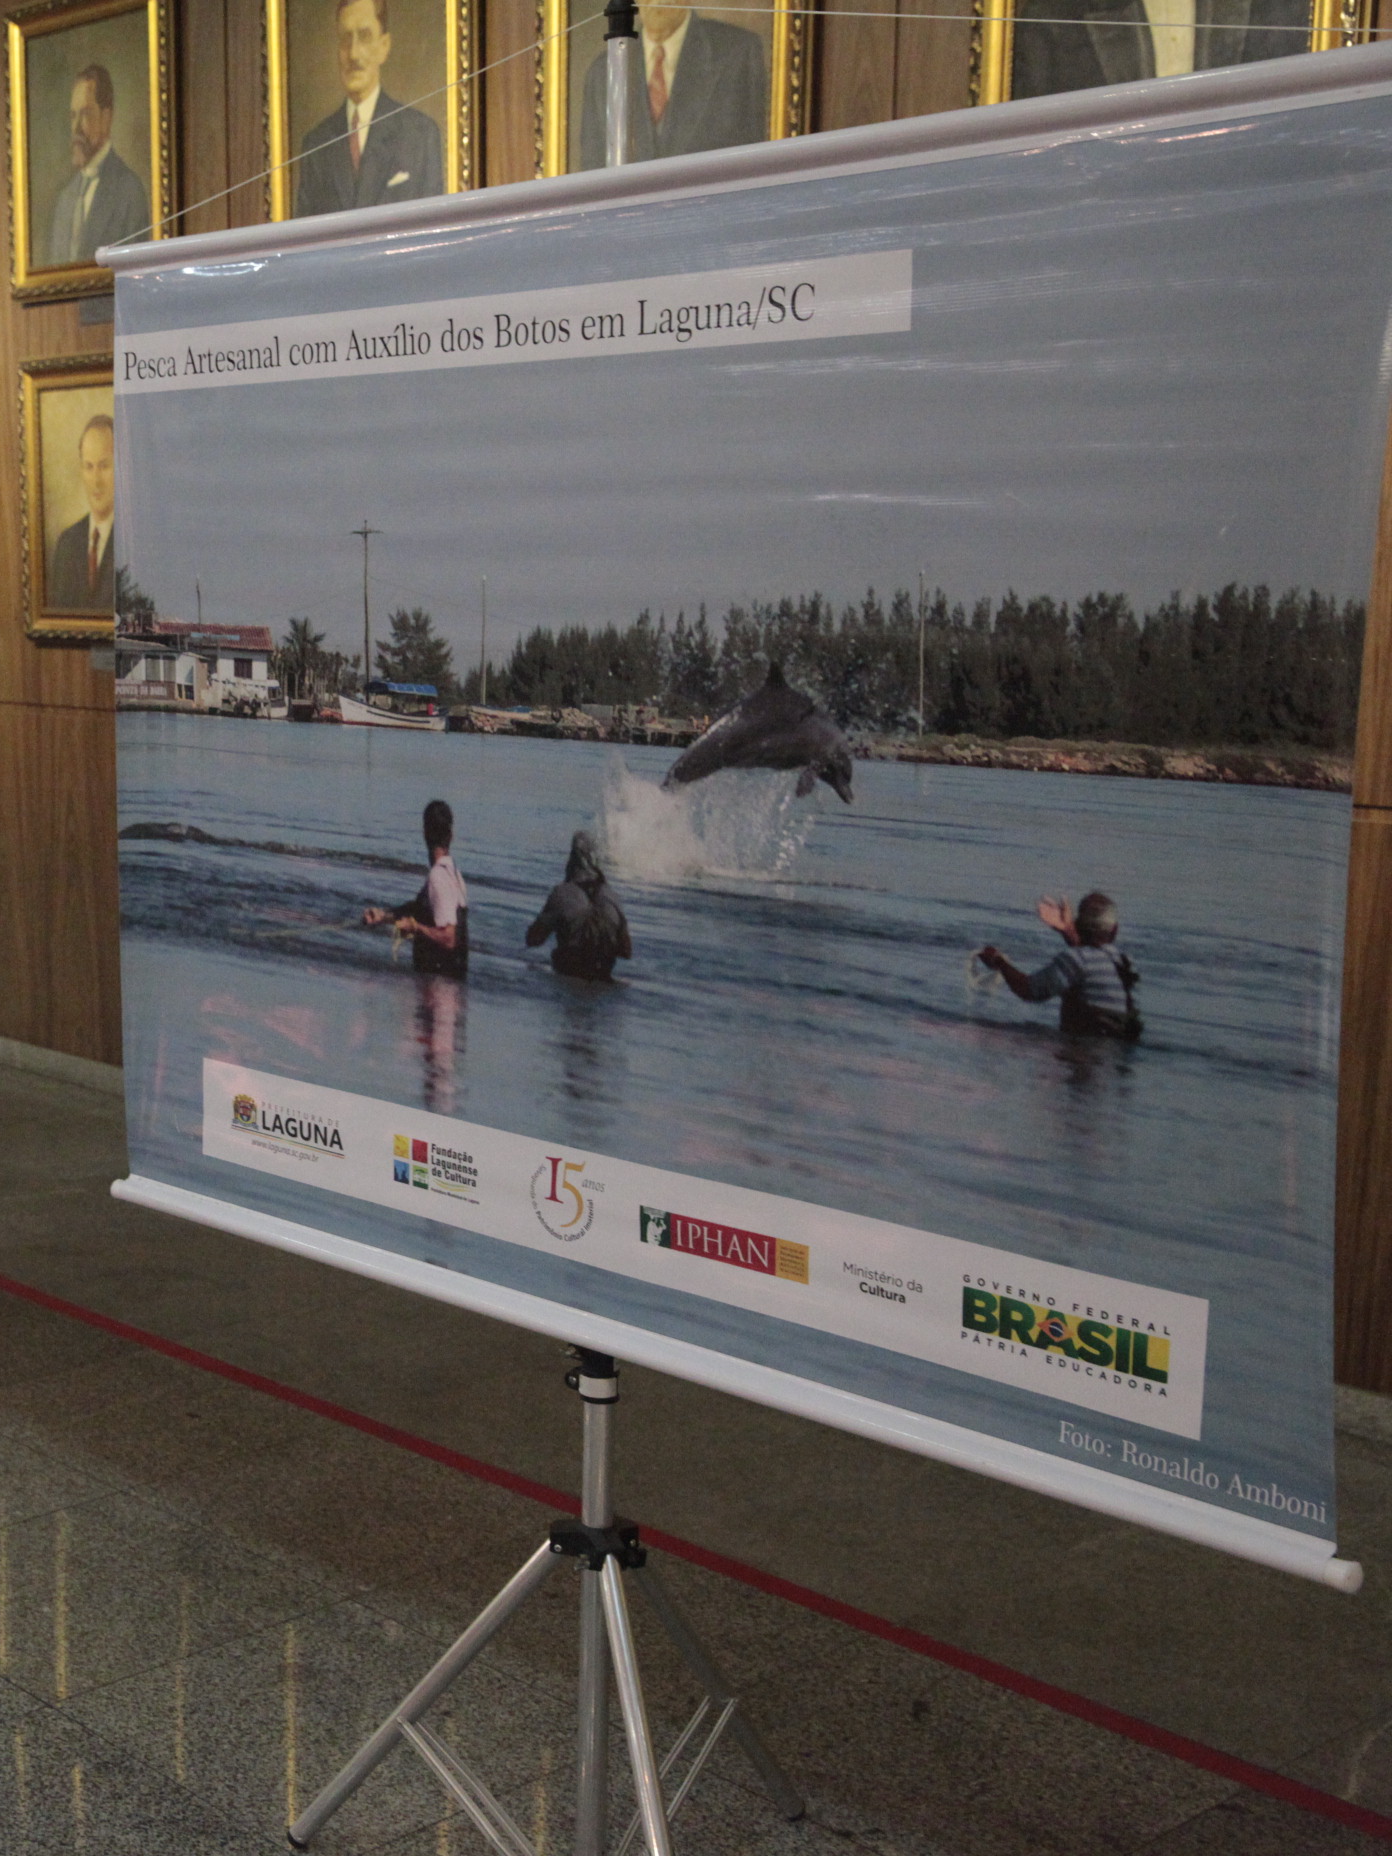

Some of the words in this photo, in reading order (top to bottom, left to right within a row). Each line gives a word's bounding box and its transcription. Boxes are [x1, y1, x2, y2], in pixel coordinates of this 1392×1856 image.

[123, 351, 177, 381] Pesca
[183, 336, 281, 376] Artesanal
[289, 339, 337, 366] com
[345, 322, 431, 361] Auxílio
[440, 318, 484, 353] dos
[494, 313, 570, 348] Botos
[581, 311, 625, 341] em
[638, 282, 816, 343] Laguna/SC
[261, 1101, 323, 1123] PREFEITURA
[327, 1117, 340, 1128] DE
[261, 1110, 344, 1150] LAGUNA
[431, 1143, 474, 1164] Fundação
[431, 1155, 478, 1177] Lagunense
[431, 1167, 442, 1178] de
[445, 1170, 477, 1188] Cultura
[581, 1179, 606, 1193] anos
[675, 1219, 769, 1268] IPHAN
[842, 1261, 903, 1288] Ministério
[907, 1279, 923, 1293] da
[859, 1281, 906, 1304] Cultura
[962, 1274, 1056, 1306] GOVERNO
[1072, 1303, 1171, 1336] FEDERAL
[962, 1286, 1170, 1384] BRASIL
[960, 1331, 1028, 1358] PÁTRIA
[1046, 1355, 1168, 1397] EDUCADORA
[1058, 1419, 1112, 1457] Foto:
[1121, 1439, 1219, 1489] Ronaldo
[1226, 1473, 1327, 1524] Amboni
